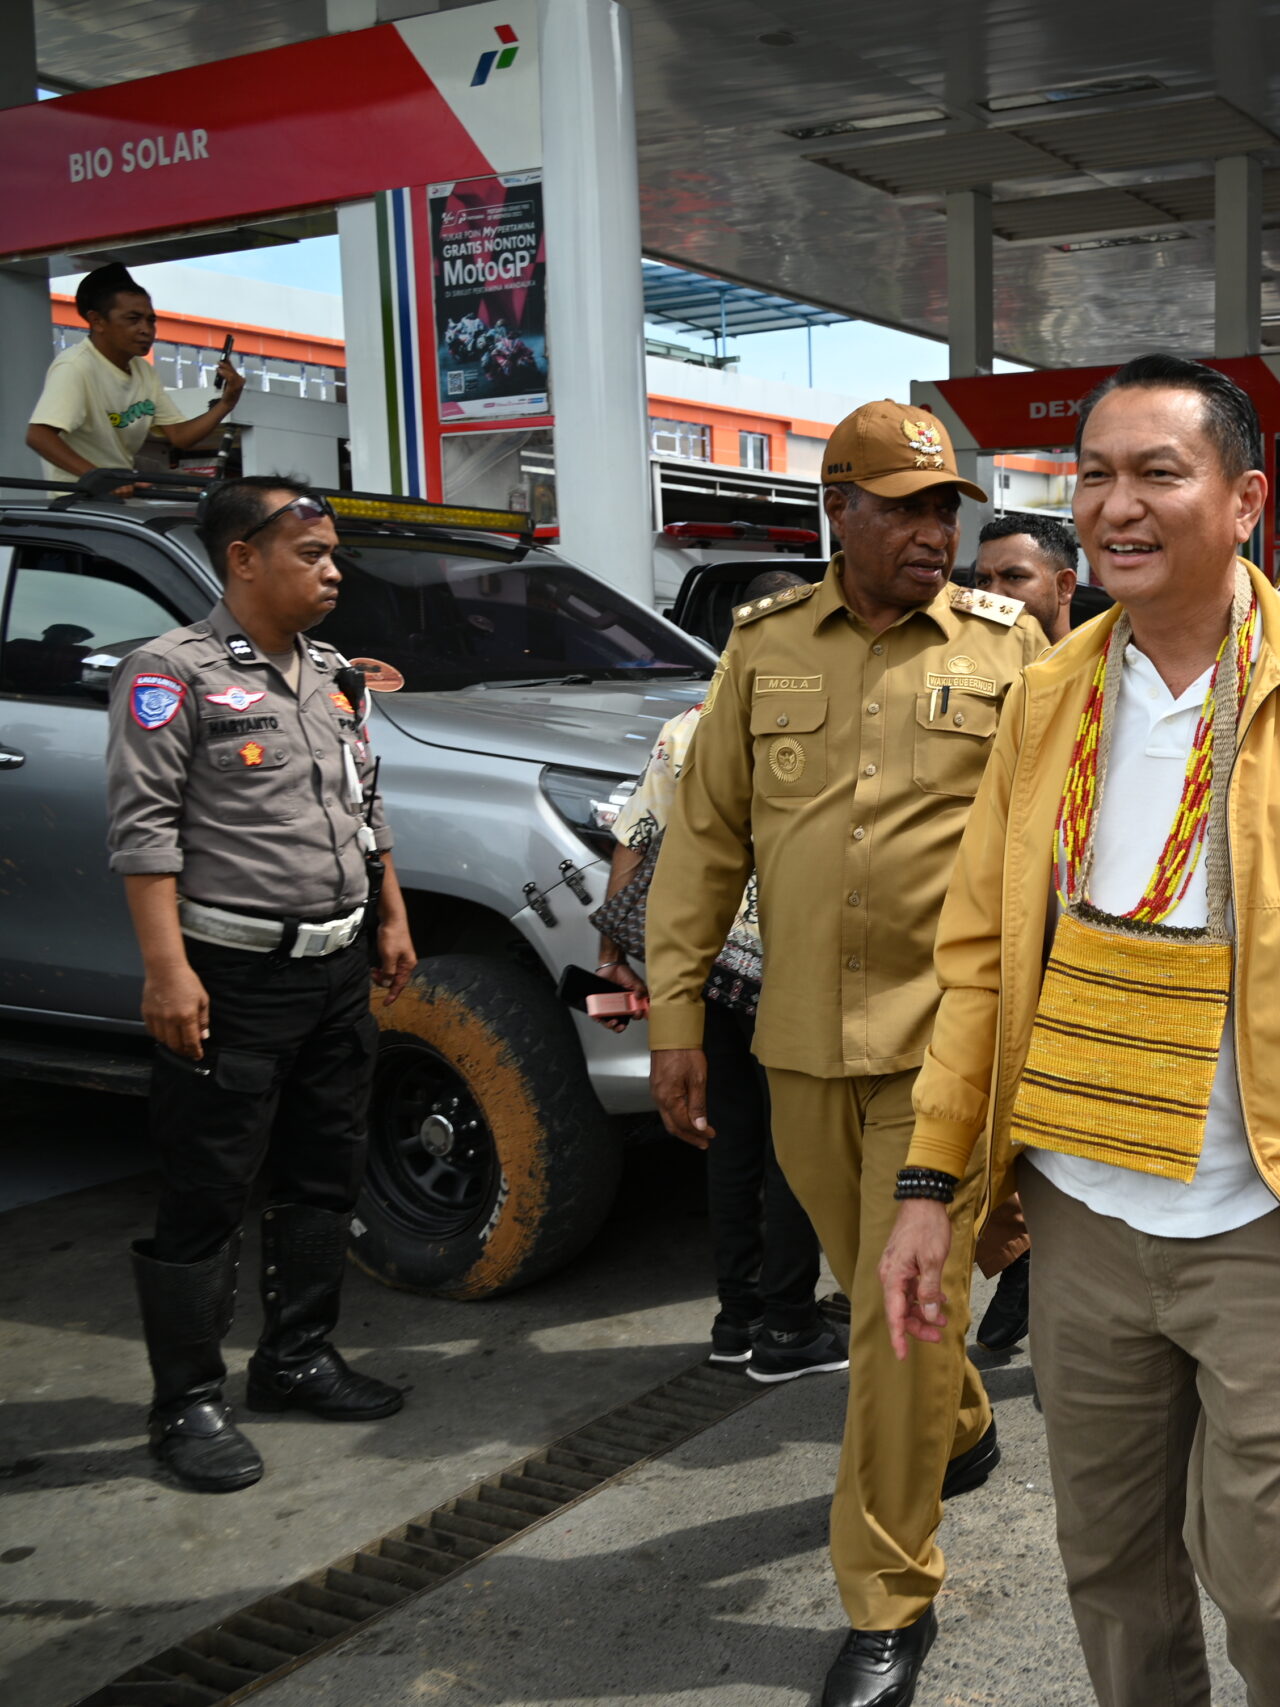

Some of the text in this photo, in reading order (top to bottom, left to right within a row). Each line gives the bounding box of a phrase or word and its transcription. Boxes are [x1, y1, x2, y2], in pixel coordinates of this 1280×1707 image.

[69, 128, 209, 183] BIO SOLAR
[443, 233, 536, 258] GRATIS NONTON
[443, 250, 530, 287] MotoGP
[768, 679, 809, 689] MOLA
[929, 676, 992, 692] WAKIL GUBERNUR
[209, 715, 278, 735] HARYANTO
